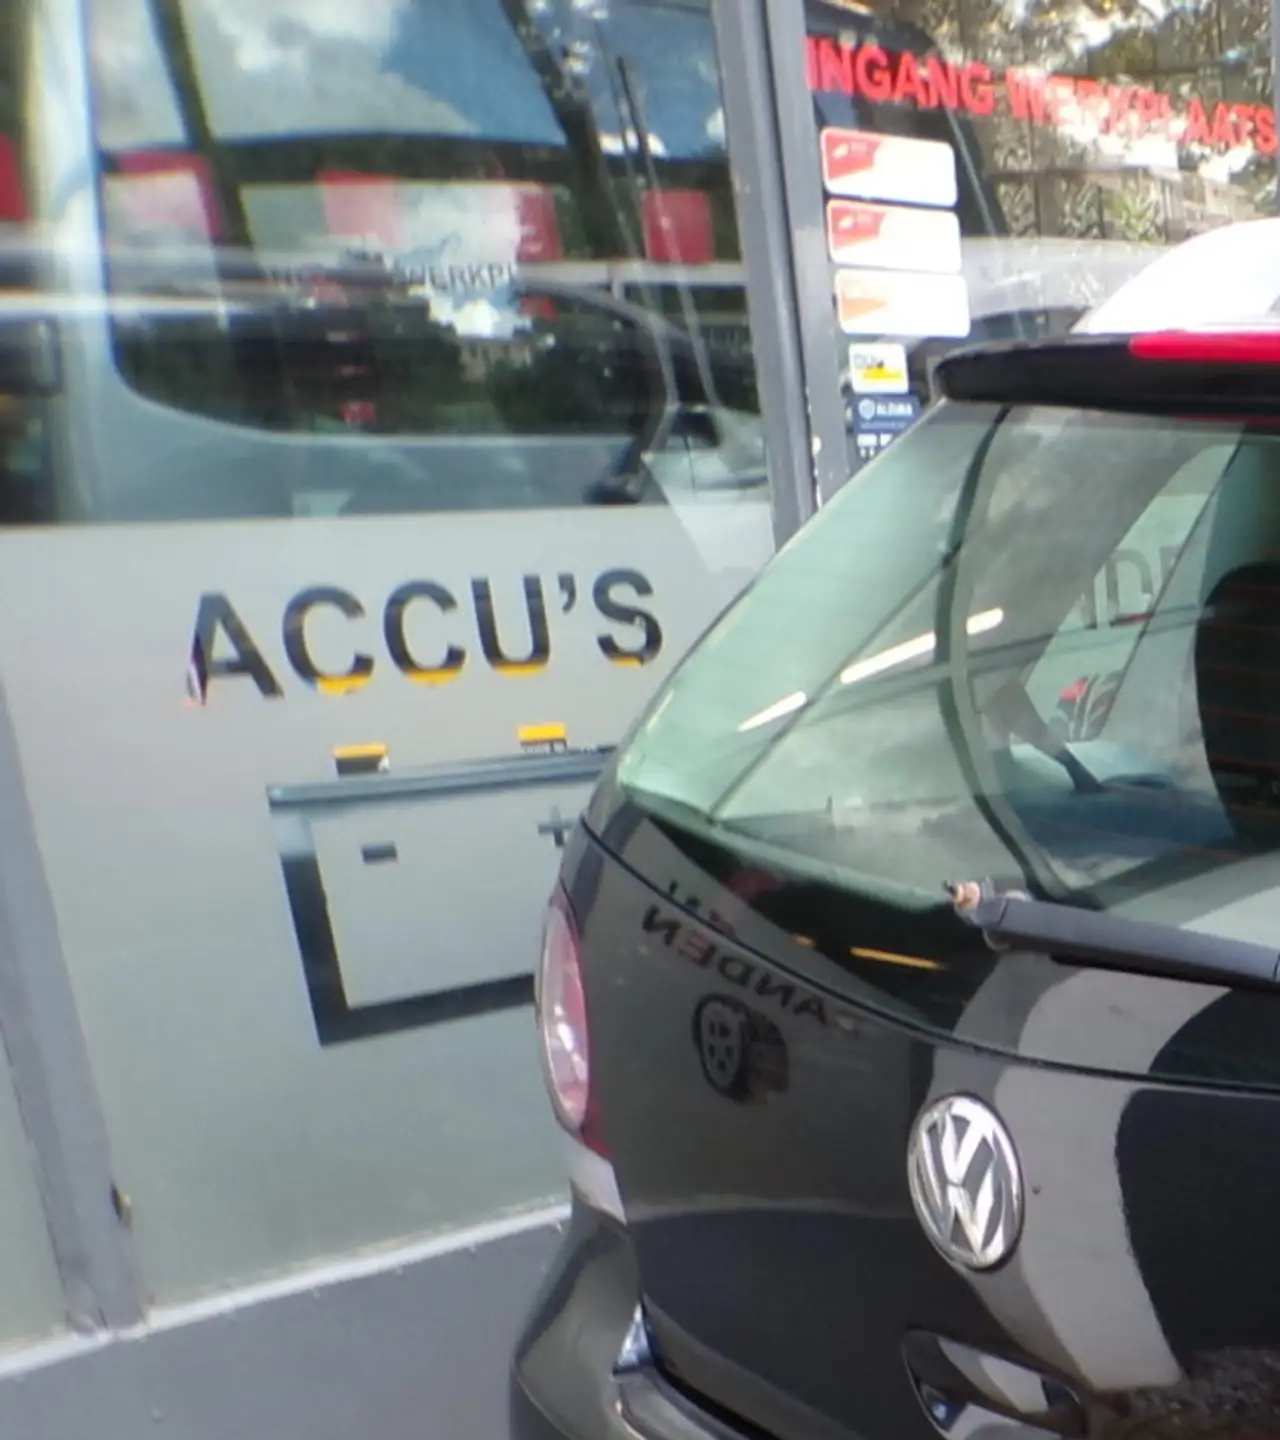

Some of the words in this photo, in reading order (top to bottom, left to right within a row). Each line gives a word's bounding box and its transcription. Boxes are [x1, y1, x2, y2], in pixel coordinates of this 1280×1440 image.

[805, 37, 995, 116] INGANG
[1004, 67, 1277, 155] WERKPLAATS
[187, 568, 664, 706] ACCU'S
